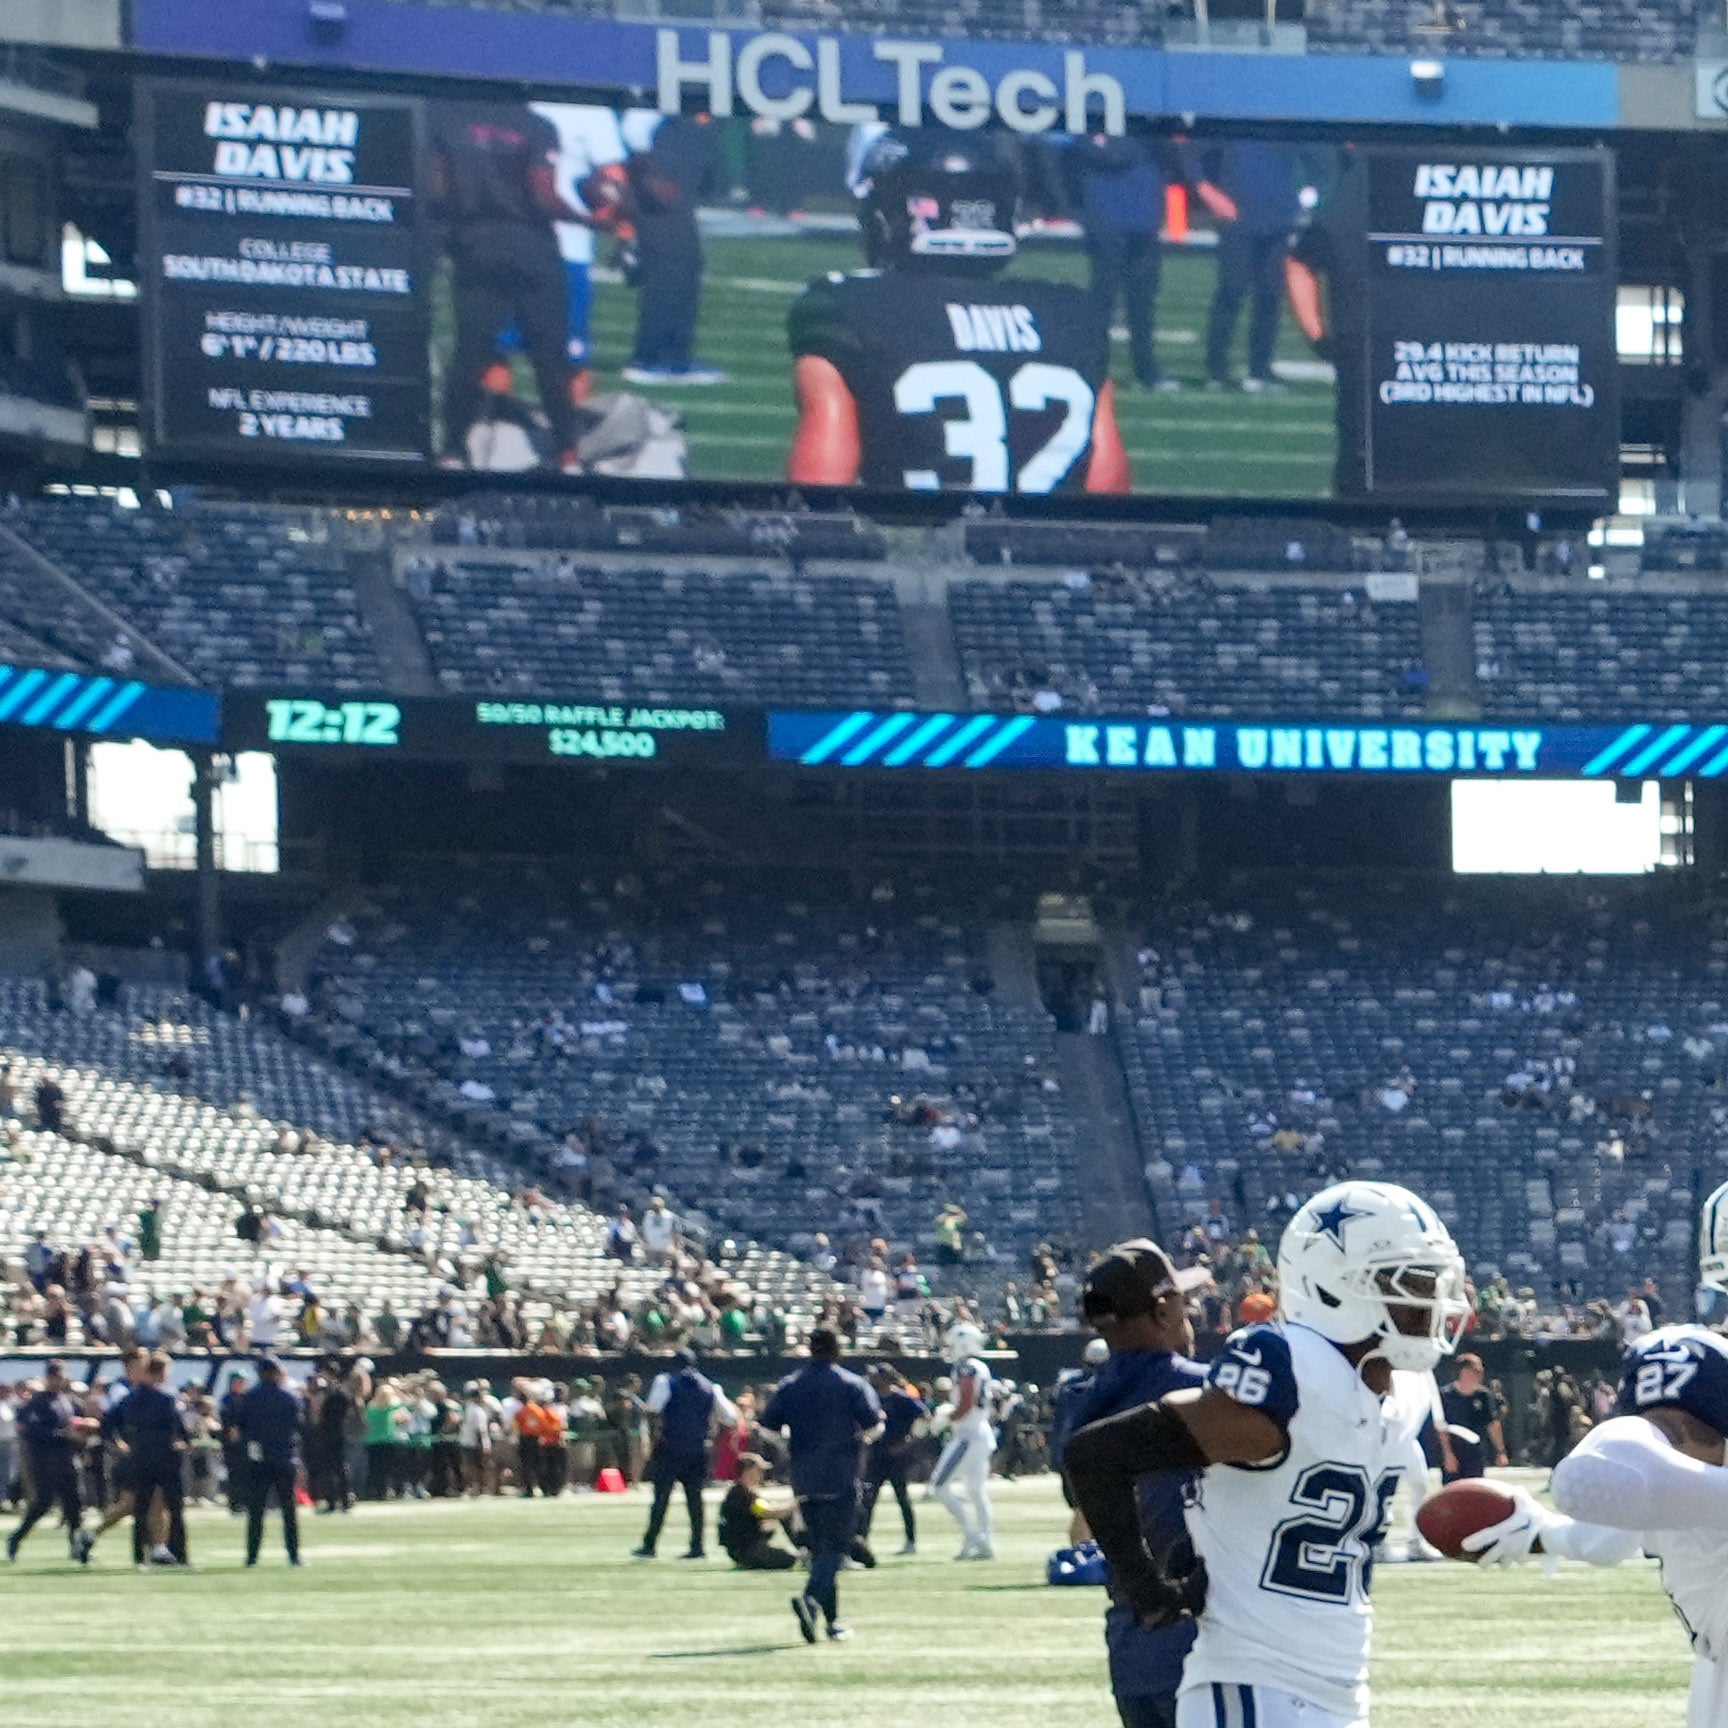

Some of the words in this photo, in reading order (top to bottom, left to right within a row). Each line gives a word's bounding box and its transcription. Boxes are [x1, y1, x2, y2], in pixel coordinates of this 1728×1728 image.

[656, 29, 1126, 136] HCLTech
[204, 101, 359, 147] ISAIAH
[214, 140, 356, 183] DAVIS
[1413, 164, 1554, 200] ISAIAH
[1422, 200, 1550, 235] DAVIS
[1529, 247, 1584, 270] BACK
[946, 303, 1042, 351] DAVIS
[893, 361, 1094, 493] 32
[266, 700, 400, 744] 12:12
[544, 704, 625, 728] RAFFLE
[1064, 724, 1218, 768] KEAN
[1236, 728, 1543, 772] UNIVERSITY
